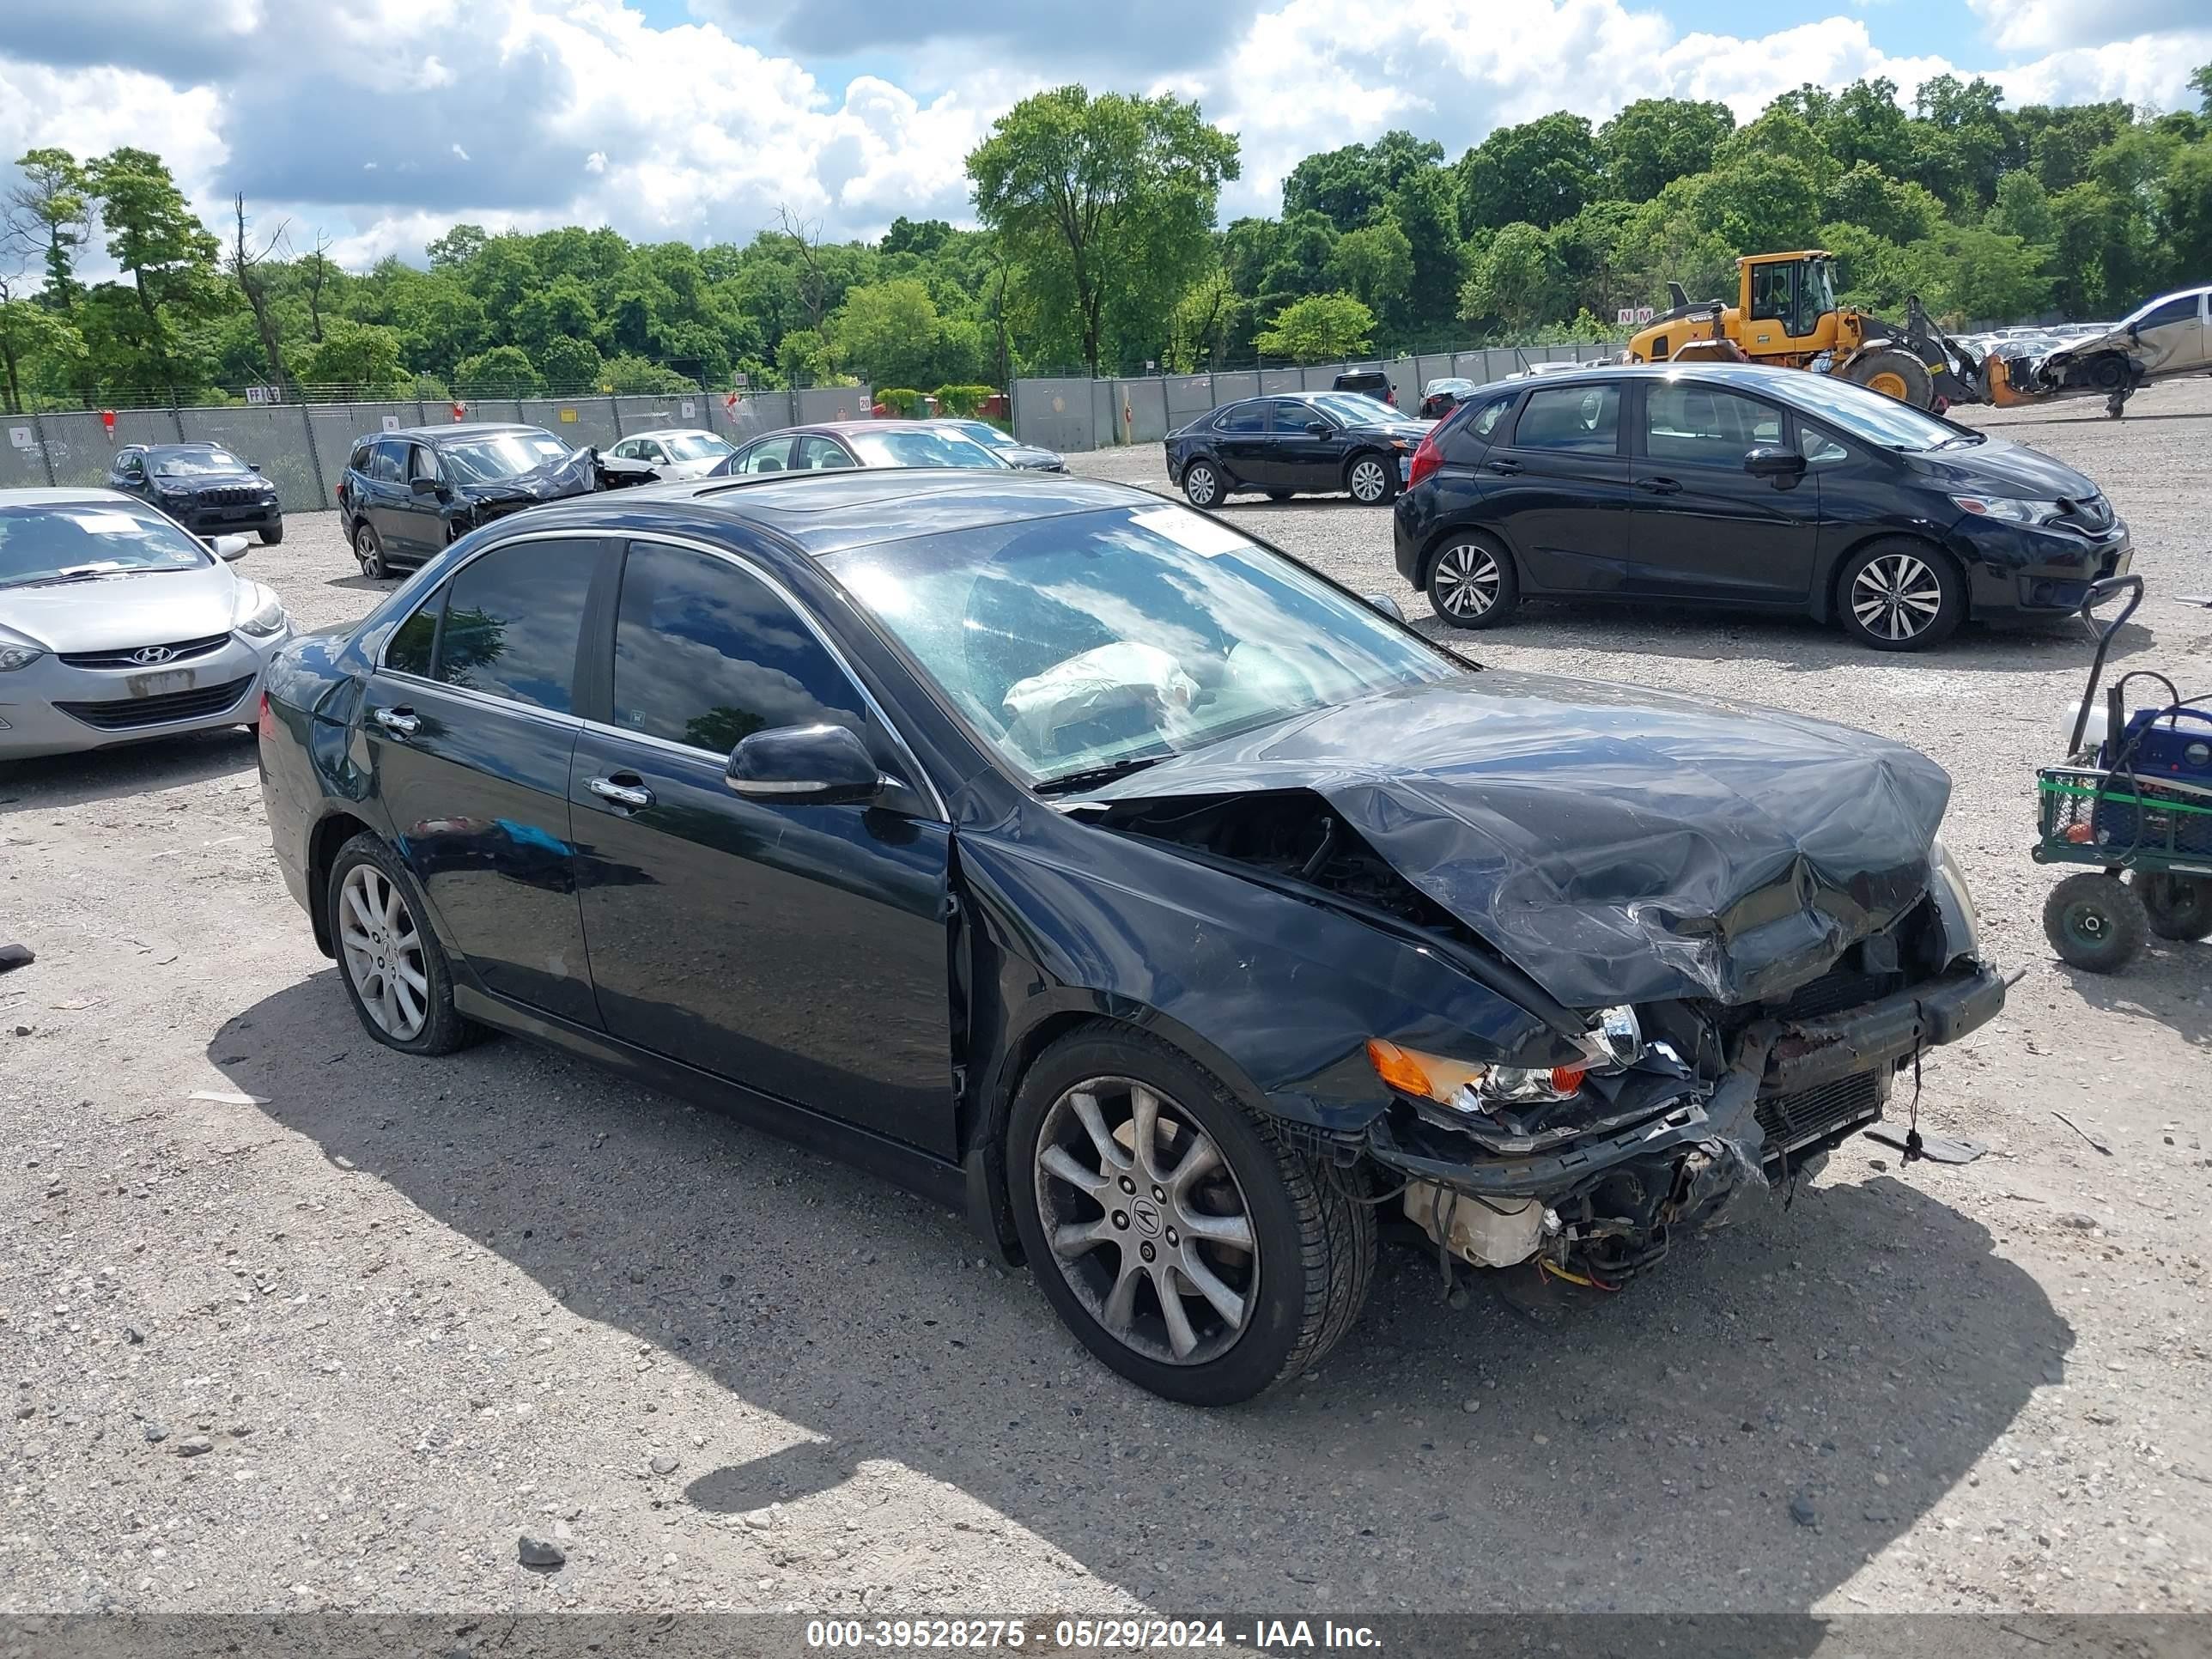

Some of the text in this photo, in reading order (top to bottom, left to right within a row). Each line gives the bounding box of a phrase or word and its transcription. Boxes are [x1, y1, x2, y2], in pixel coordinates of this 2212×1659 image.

[1621, 311, 1631, 322] N
[1638, 311, 1651, 323] M
[249, 389, 259, 401] FF
[860, 399, 870, 409] 20
